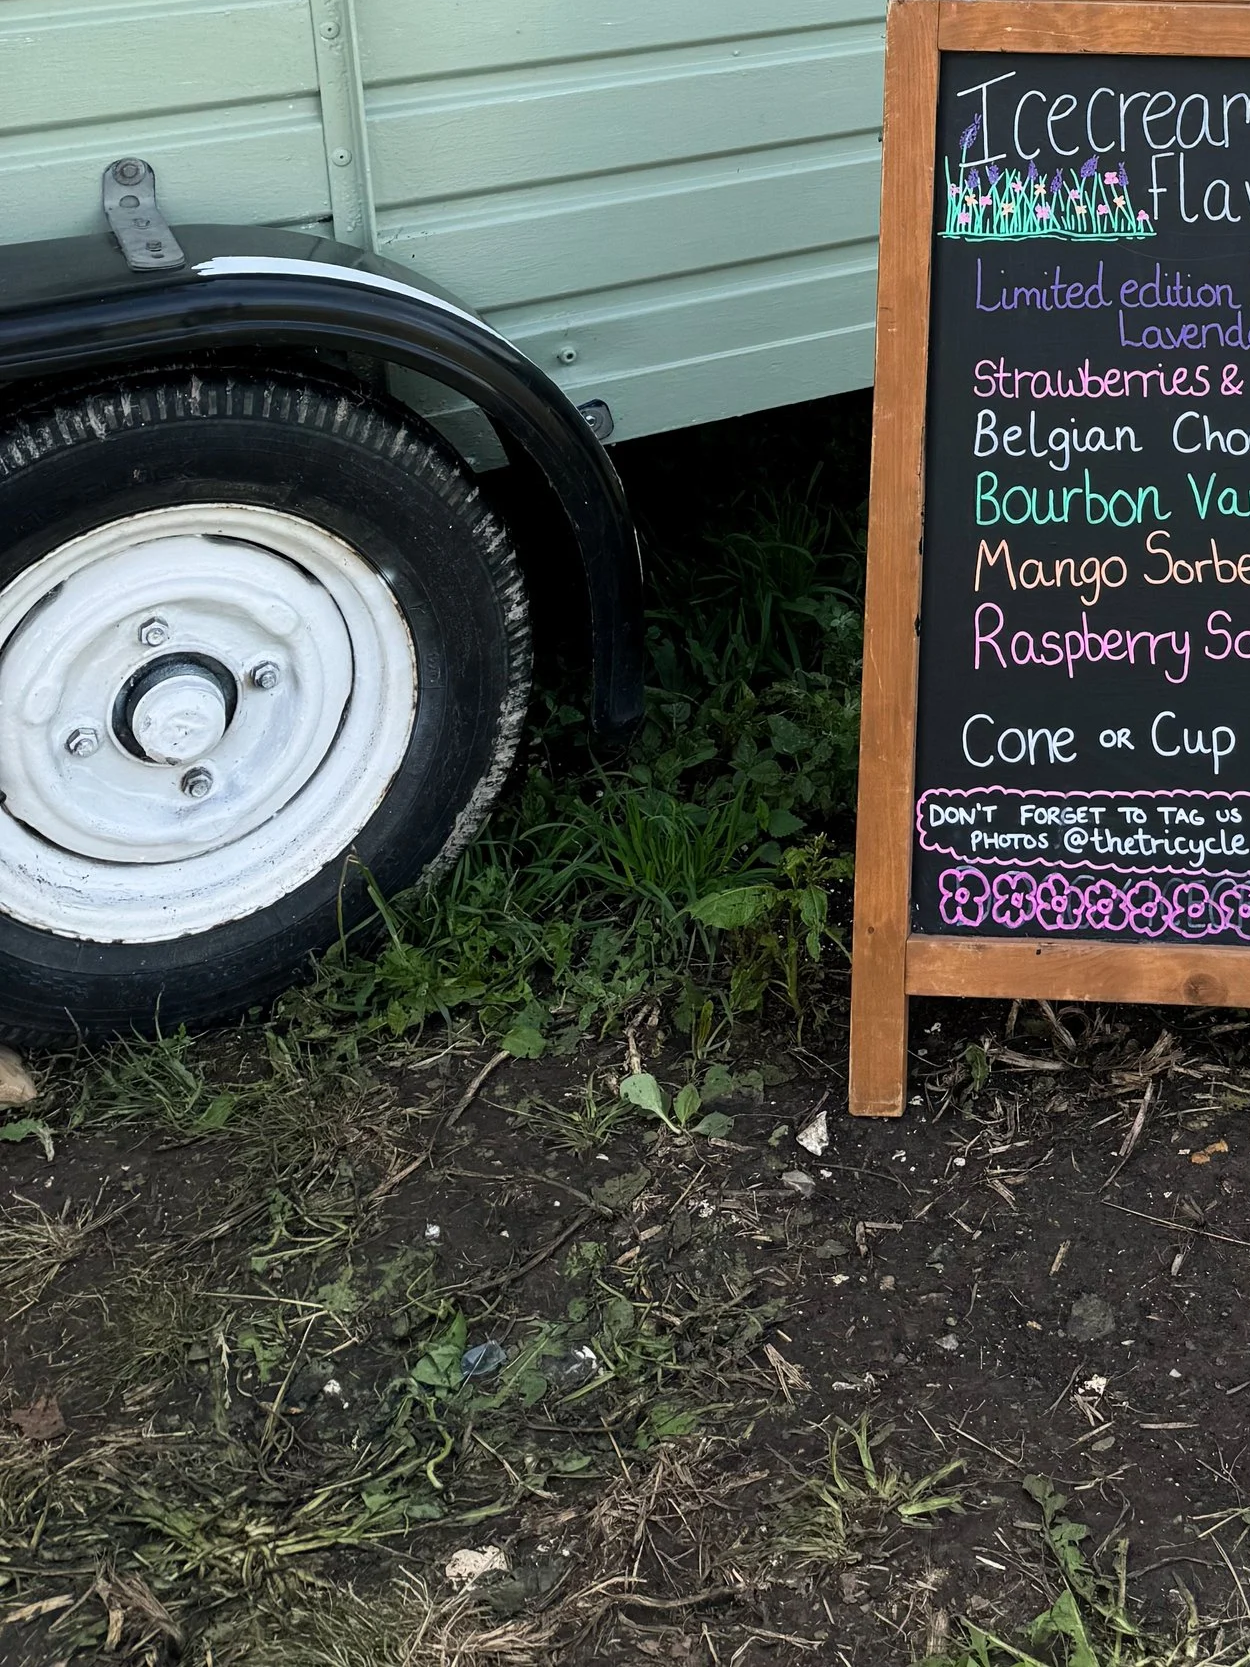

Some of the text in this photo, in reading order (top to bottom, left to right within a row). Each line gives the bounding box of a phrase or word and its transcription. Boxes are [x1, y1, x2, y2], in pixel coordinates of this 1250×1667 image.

[975, 257, 1113, 312] Limited
[1119, 262, 1241, 310] edition
[973, 356, 1211, 399] Strawberries
[1220, 363, 1245, 396] &
[973, 408, 1144, 472] Belgian
[975, 467, 1173, 528] Bourbon
[974, 539, 1128, 607] Mango
[972, 601, 1192, 684] Raspberry
[962, 713, 1078, 768] Cone
[1151, 710, 1236, 775] Cup
[929, 802, 998, 828] DON'T
[1019, 804, 1107, 827] FORGET
[1116, 806, 1148, 825] TO
[1156, 806, 1206, 826] TAG
[1215, 807, 1243, 824] US
[970, 826, 1250, 868] PHOTOS @thetricycle
